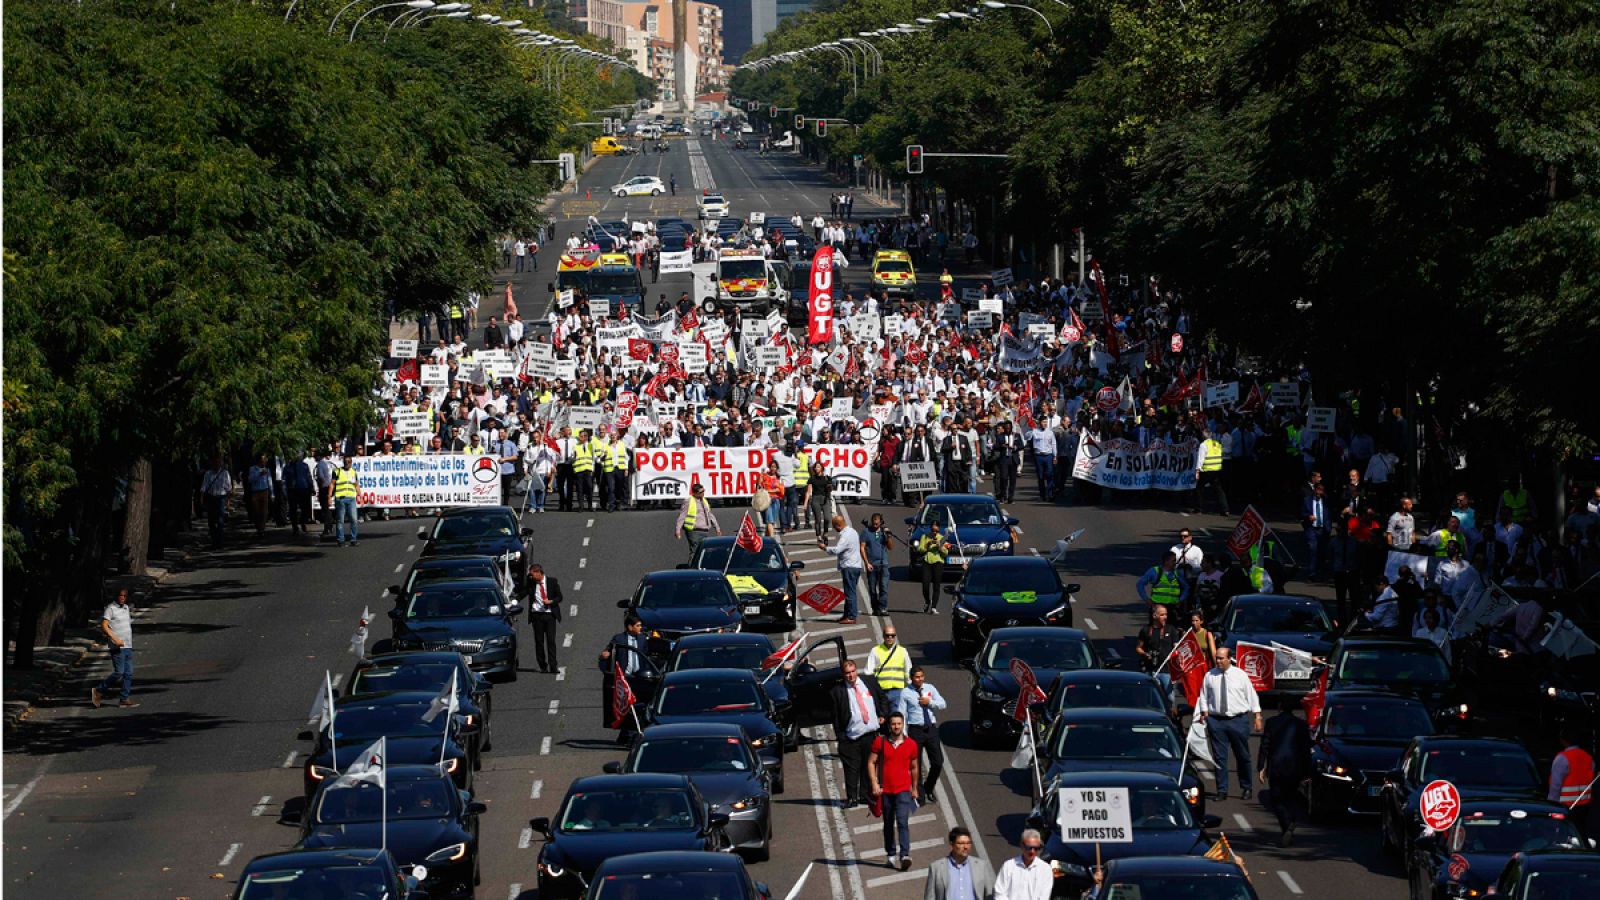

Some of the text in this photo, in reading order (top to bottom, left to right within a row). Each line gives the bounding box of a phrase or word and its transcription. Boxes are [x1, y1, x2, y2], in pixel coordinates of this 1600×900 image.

[814, 271, 832, 334] UGT
[363, 458, 371, 472] el
[440, 457, 451, 470] de
[453, 456, 465, 470] los
[635, 451, 686, 471] POR
[703, 450, 733, 469] EL
[1106, 451, 1122, 471] En
[379, 473, 390, 487] de
[392, 472, 423, 488] trabajo
[425, 472, 436, 486] de
[438, 472, 449, 486] las
[451, 472, 469, 486] VTC
[377, 494, 401, 504] FAMILIAS
[403, 494, 410, 504] SE
[411, 493, 434, 503] QUEDAN
[436, 492, 443, 502] EN
[444, 492, 451, 502] LA
[453, 492, 471, 502] CALLE
[1080, 790, 1106, 802] YO SI
[1423, 783, 1452, 811] UGT
[1081, 808, 1108, 820] PAGO
[1068, 827, 1125, 839] IMPUESTOS
